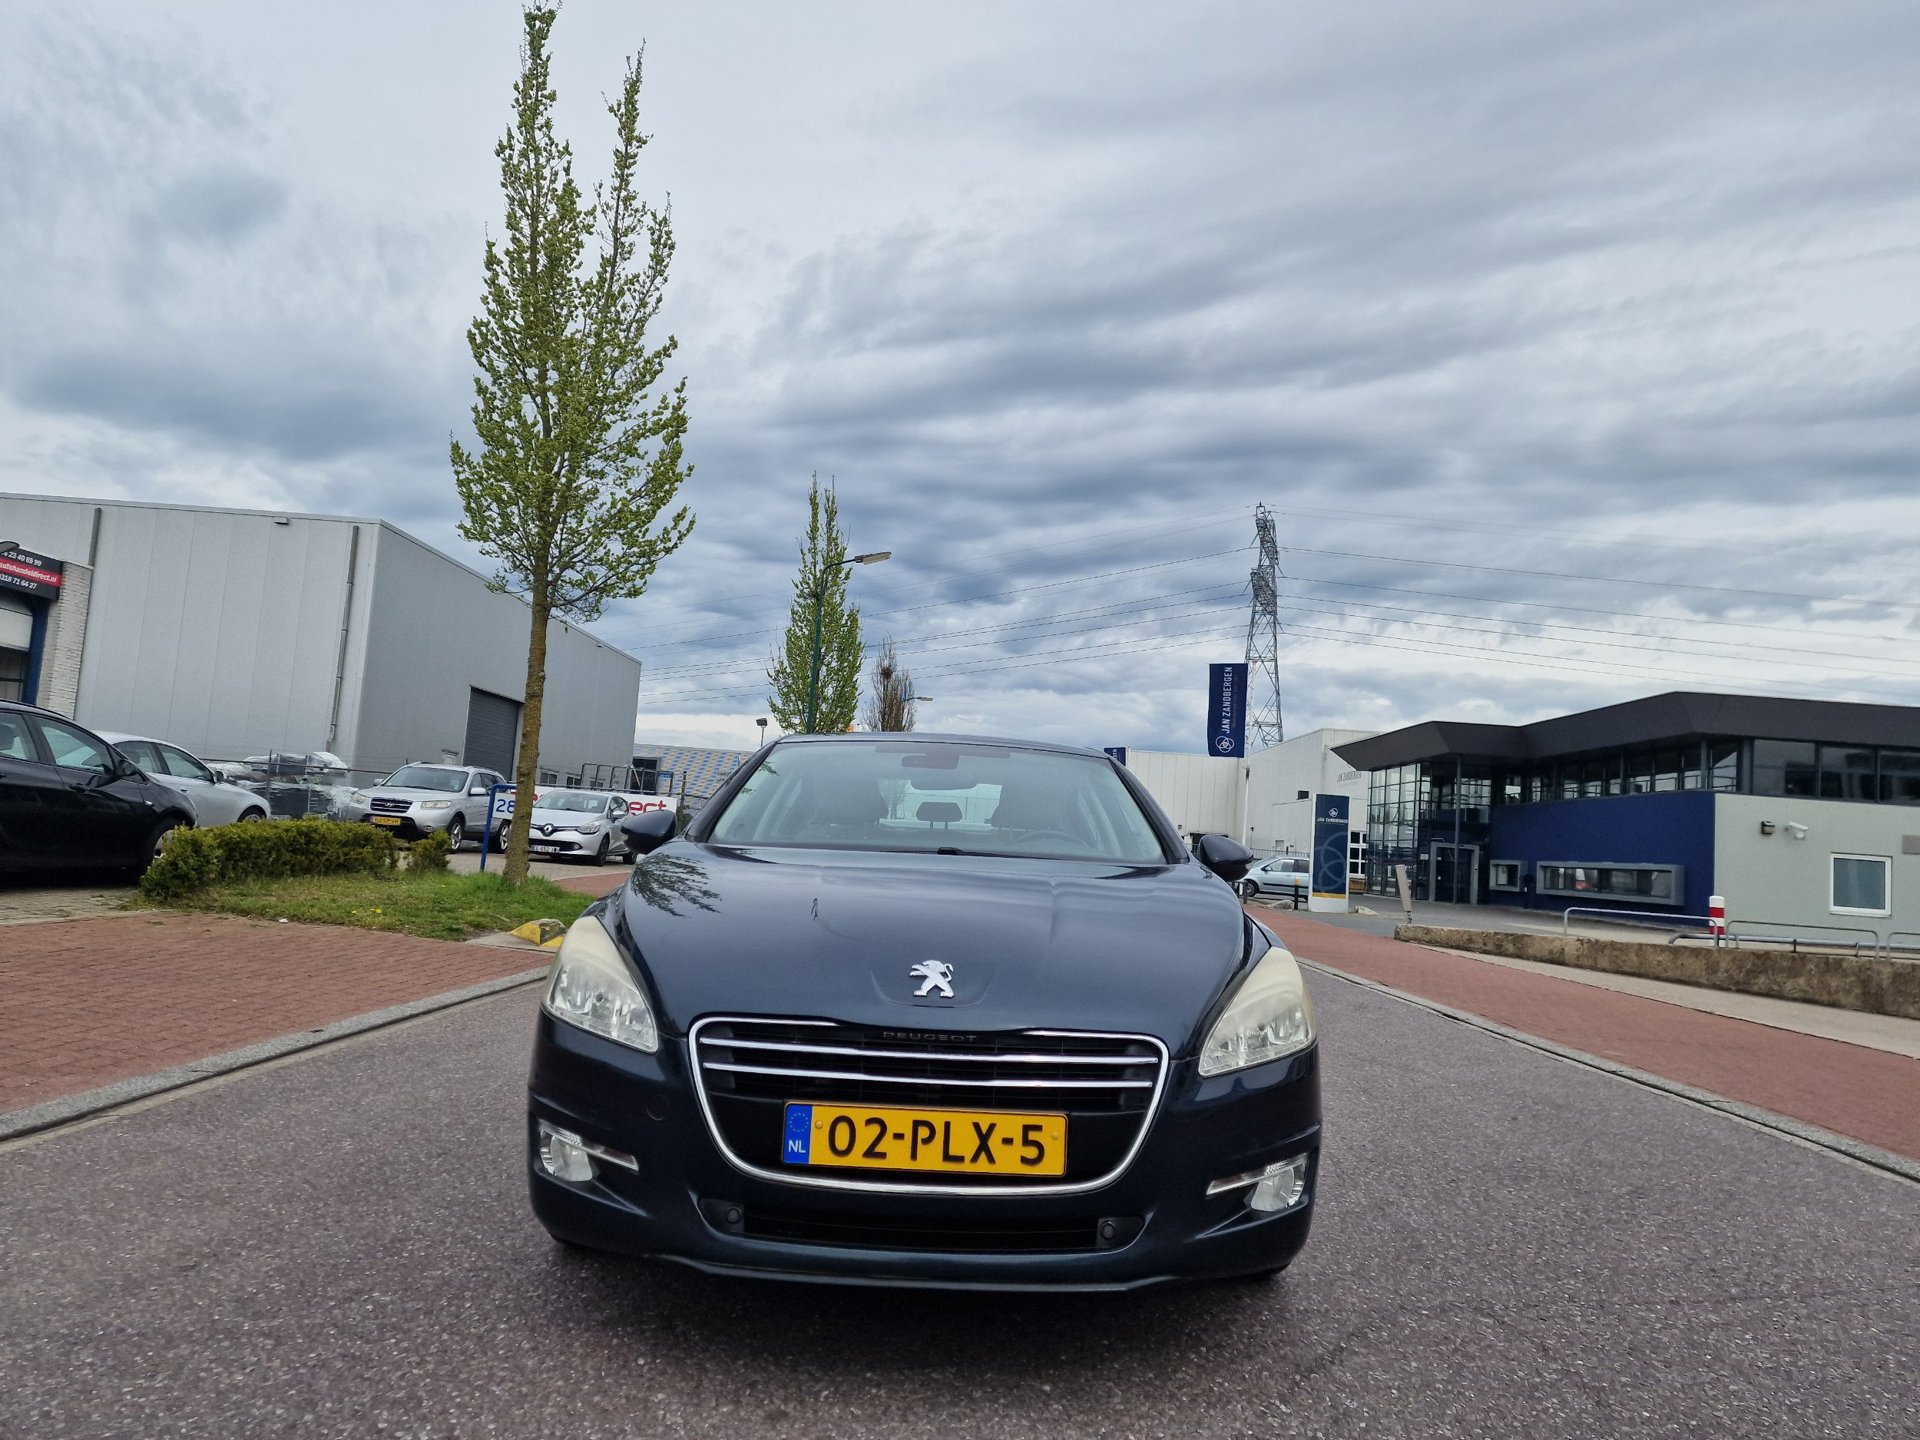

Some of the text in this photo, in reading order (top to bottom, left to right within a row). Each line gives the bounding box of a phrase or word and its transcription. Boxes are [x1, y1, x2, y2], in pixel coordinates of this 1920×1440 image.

[1222, 666, 1233, 734] JAN ZANDBERGEN
[883, 1031, 977, 1042] PEUGEOT
[788, 1139, 807, 1154] NL
[827, 1115, 1045, 1166] 02-PLX-5
